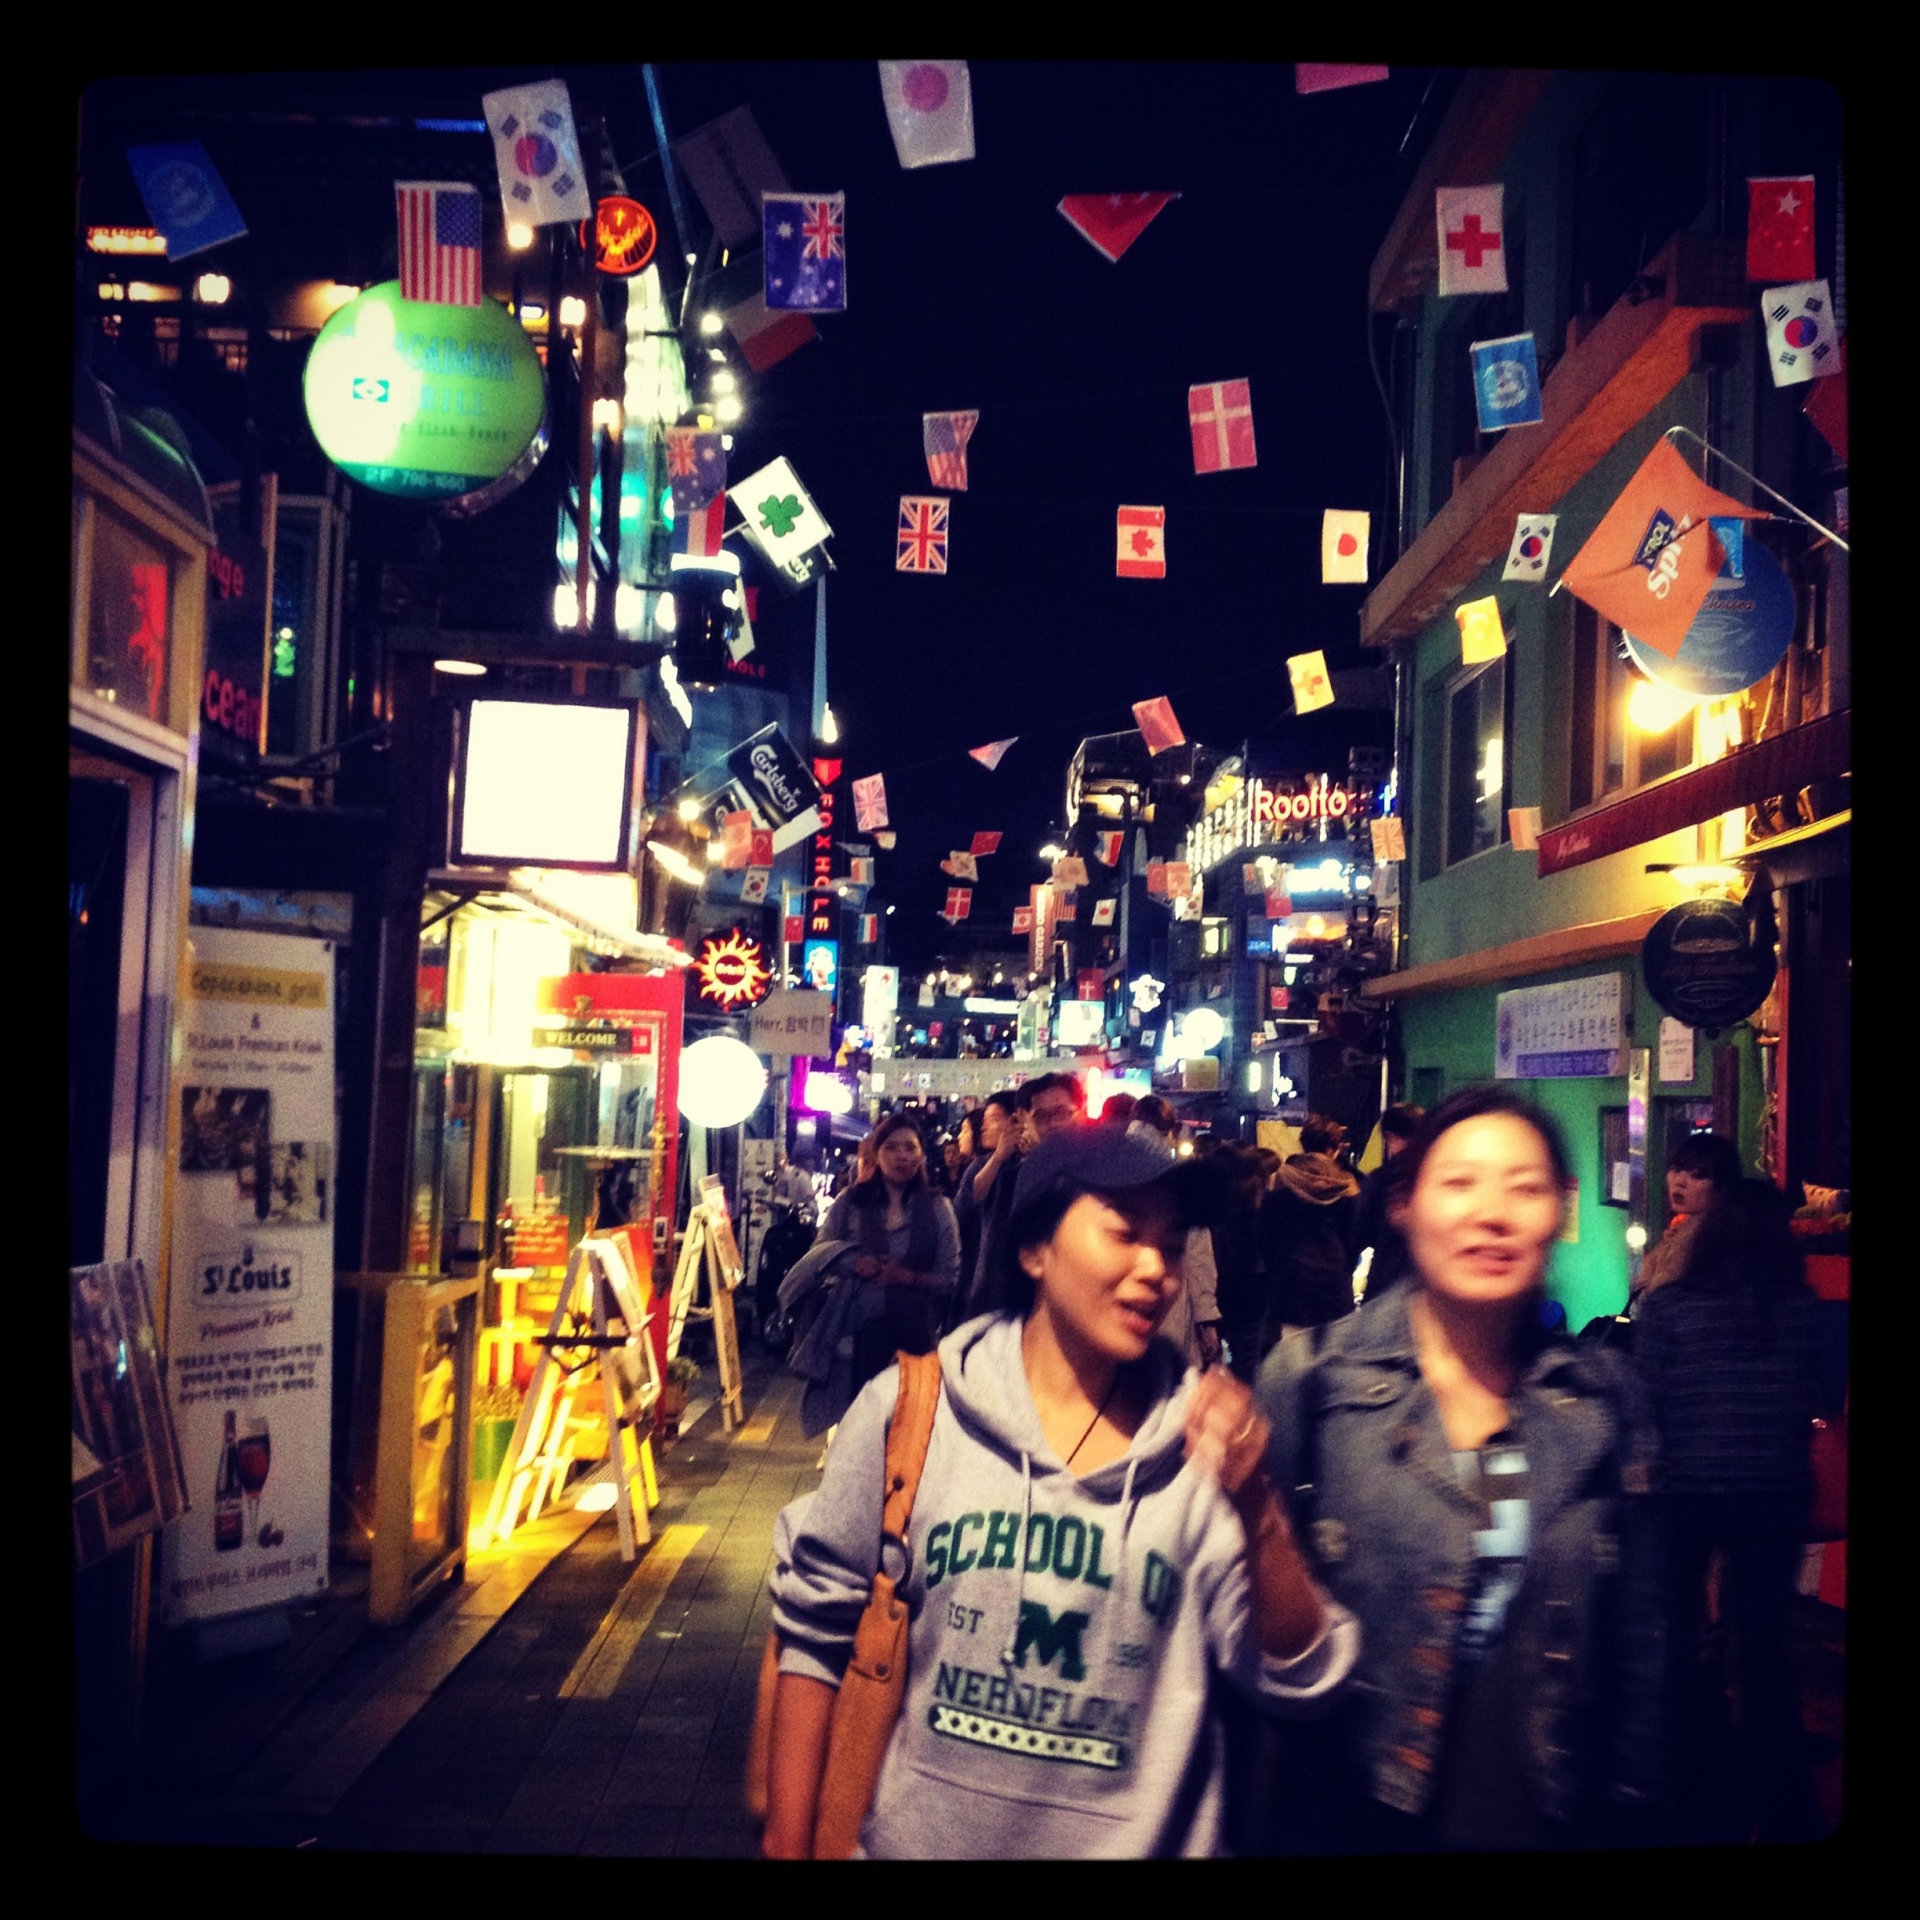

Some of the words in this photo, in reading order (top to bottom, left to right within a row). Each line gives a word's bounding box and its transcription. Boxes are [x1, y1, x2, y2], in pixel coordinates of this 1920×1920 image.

[750, 744, 799, 813] Carlsberg
[545, 1031, 617, 1046] WELCOME
[926, 1510, 1113, 1590] SCHOOL
[1011, 1600, 1090, 1683] M
